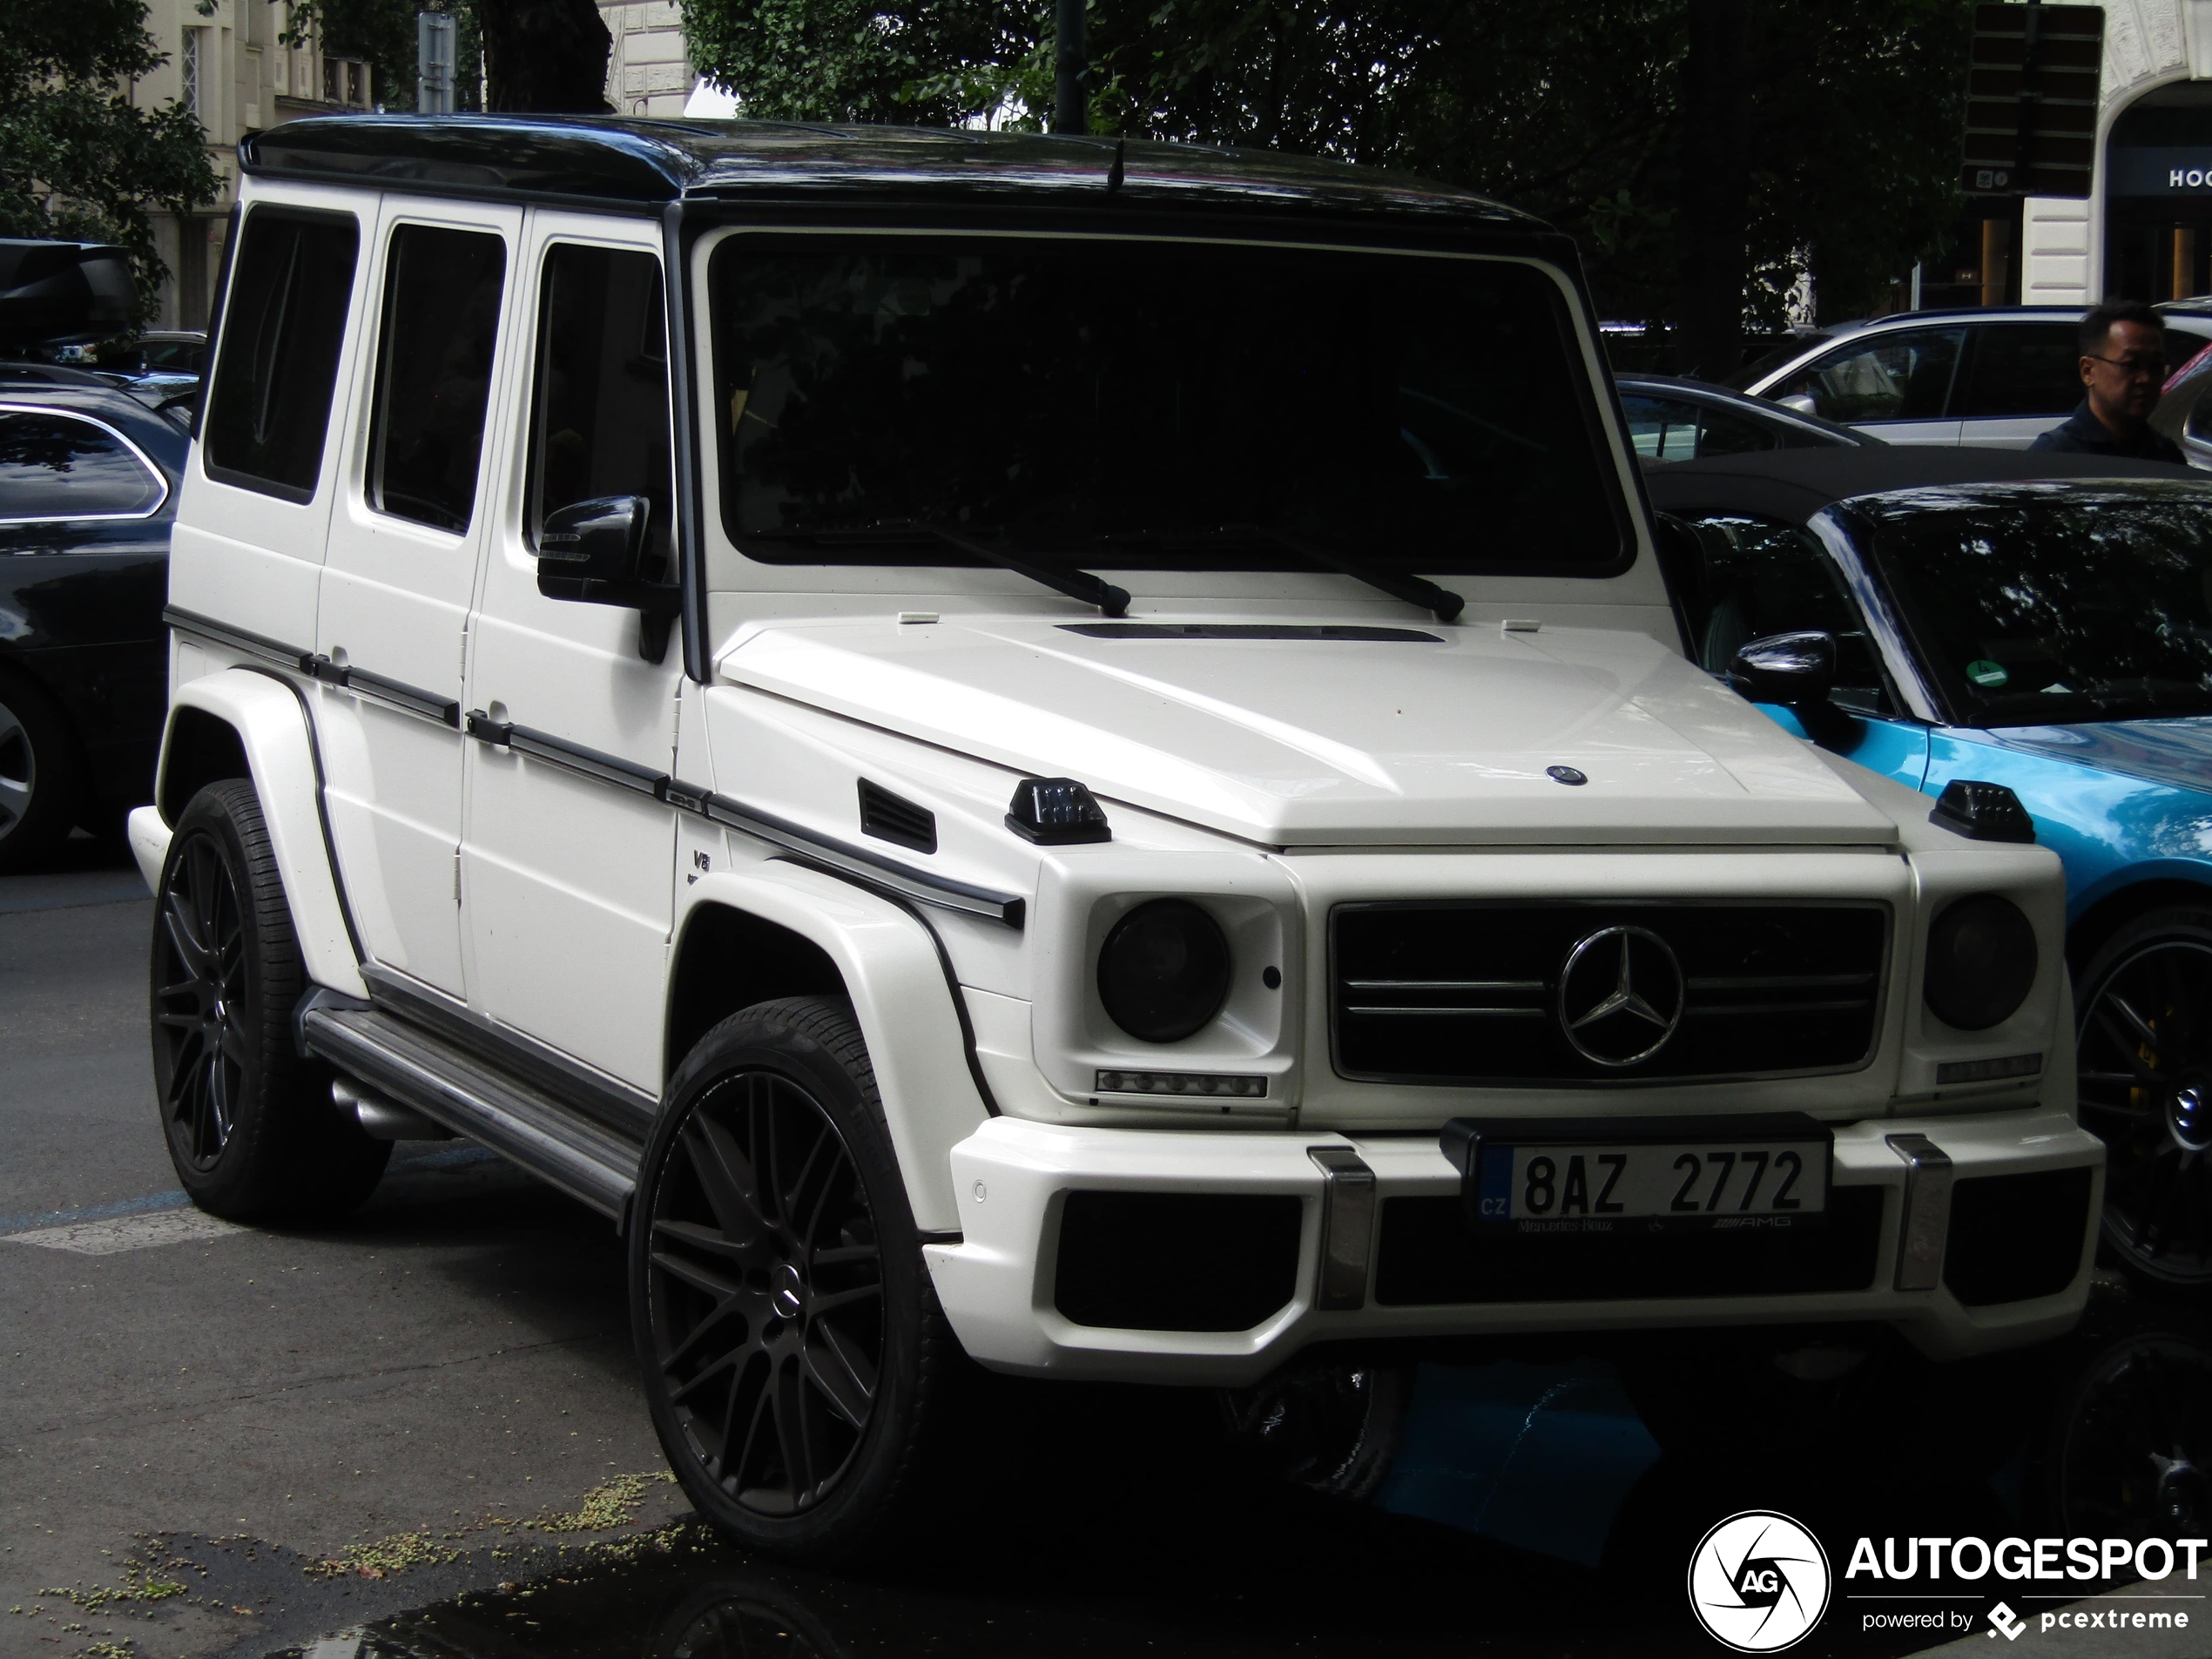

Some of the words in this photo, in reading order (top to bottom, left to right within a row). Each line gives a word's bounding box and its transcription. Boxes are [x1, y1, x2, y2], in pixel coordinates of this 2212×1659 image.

[693, 849, 711, 872] V8
[1525, 1154, 1628, 1216] 8AZ
[1670, 1150, 1803, 1211] 2772
[1481, 1197, 1506, 1216] CZ
